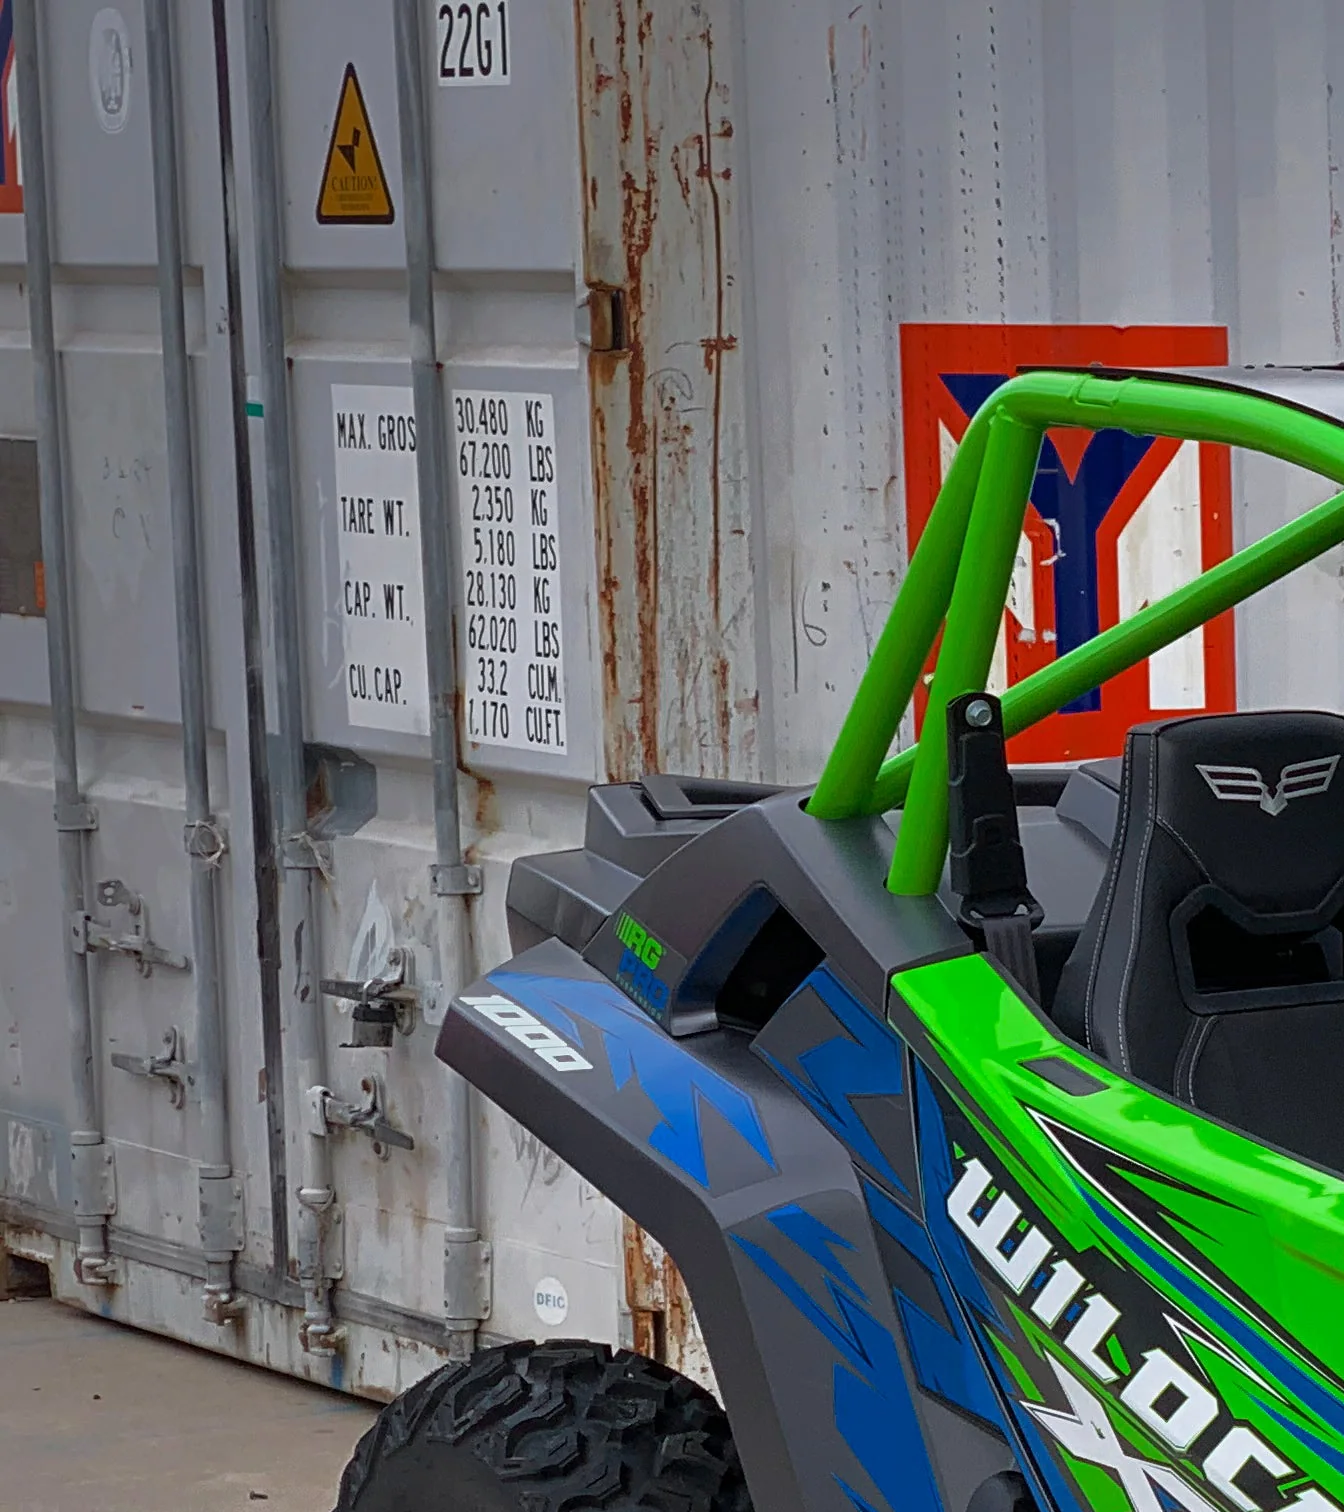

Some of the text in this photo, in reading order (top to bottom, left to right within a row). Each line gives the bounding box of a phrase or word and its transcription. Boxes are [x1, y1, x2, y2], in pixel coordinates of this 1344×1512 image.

[438, 2, 508, 78] 22G1
[336, 412, 417, 452] MAX. GROS
[525, 399, 544, 439] KG
[528, 445, 554, 482] LBS
[341, 496, 411, 537] TARE WT.
[530, 488, 548, 527] KG
[531, 532, 557, 571] LBS
[344, 580, 411, 622] CAP. WT.
[533, 576, 551, 615] KG
[534, 620, 560, 659] LBS
[477, 656, 509, 697] 33.2
[617, 947, 671, 1010] PRO
[458, 994, 594, 1072] 1000
[536, 1292, 566, 1310] DFIC
